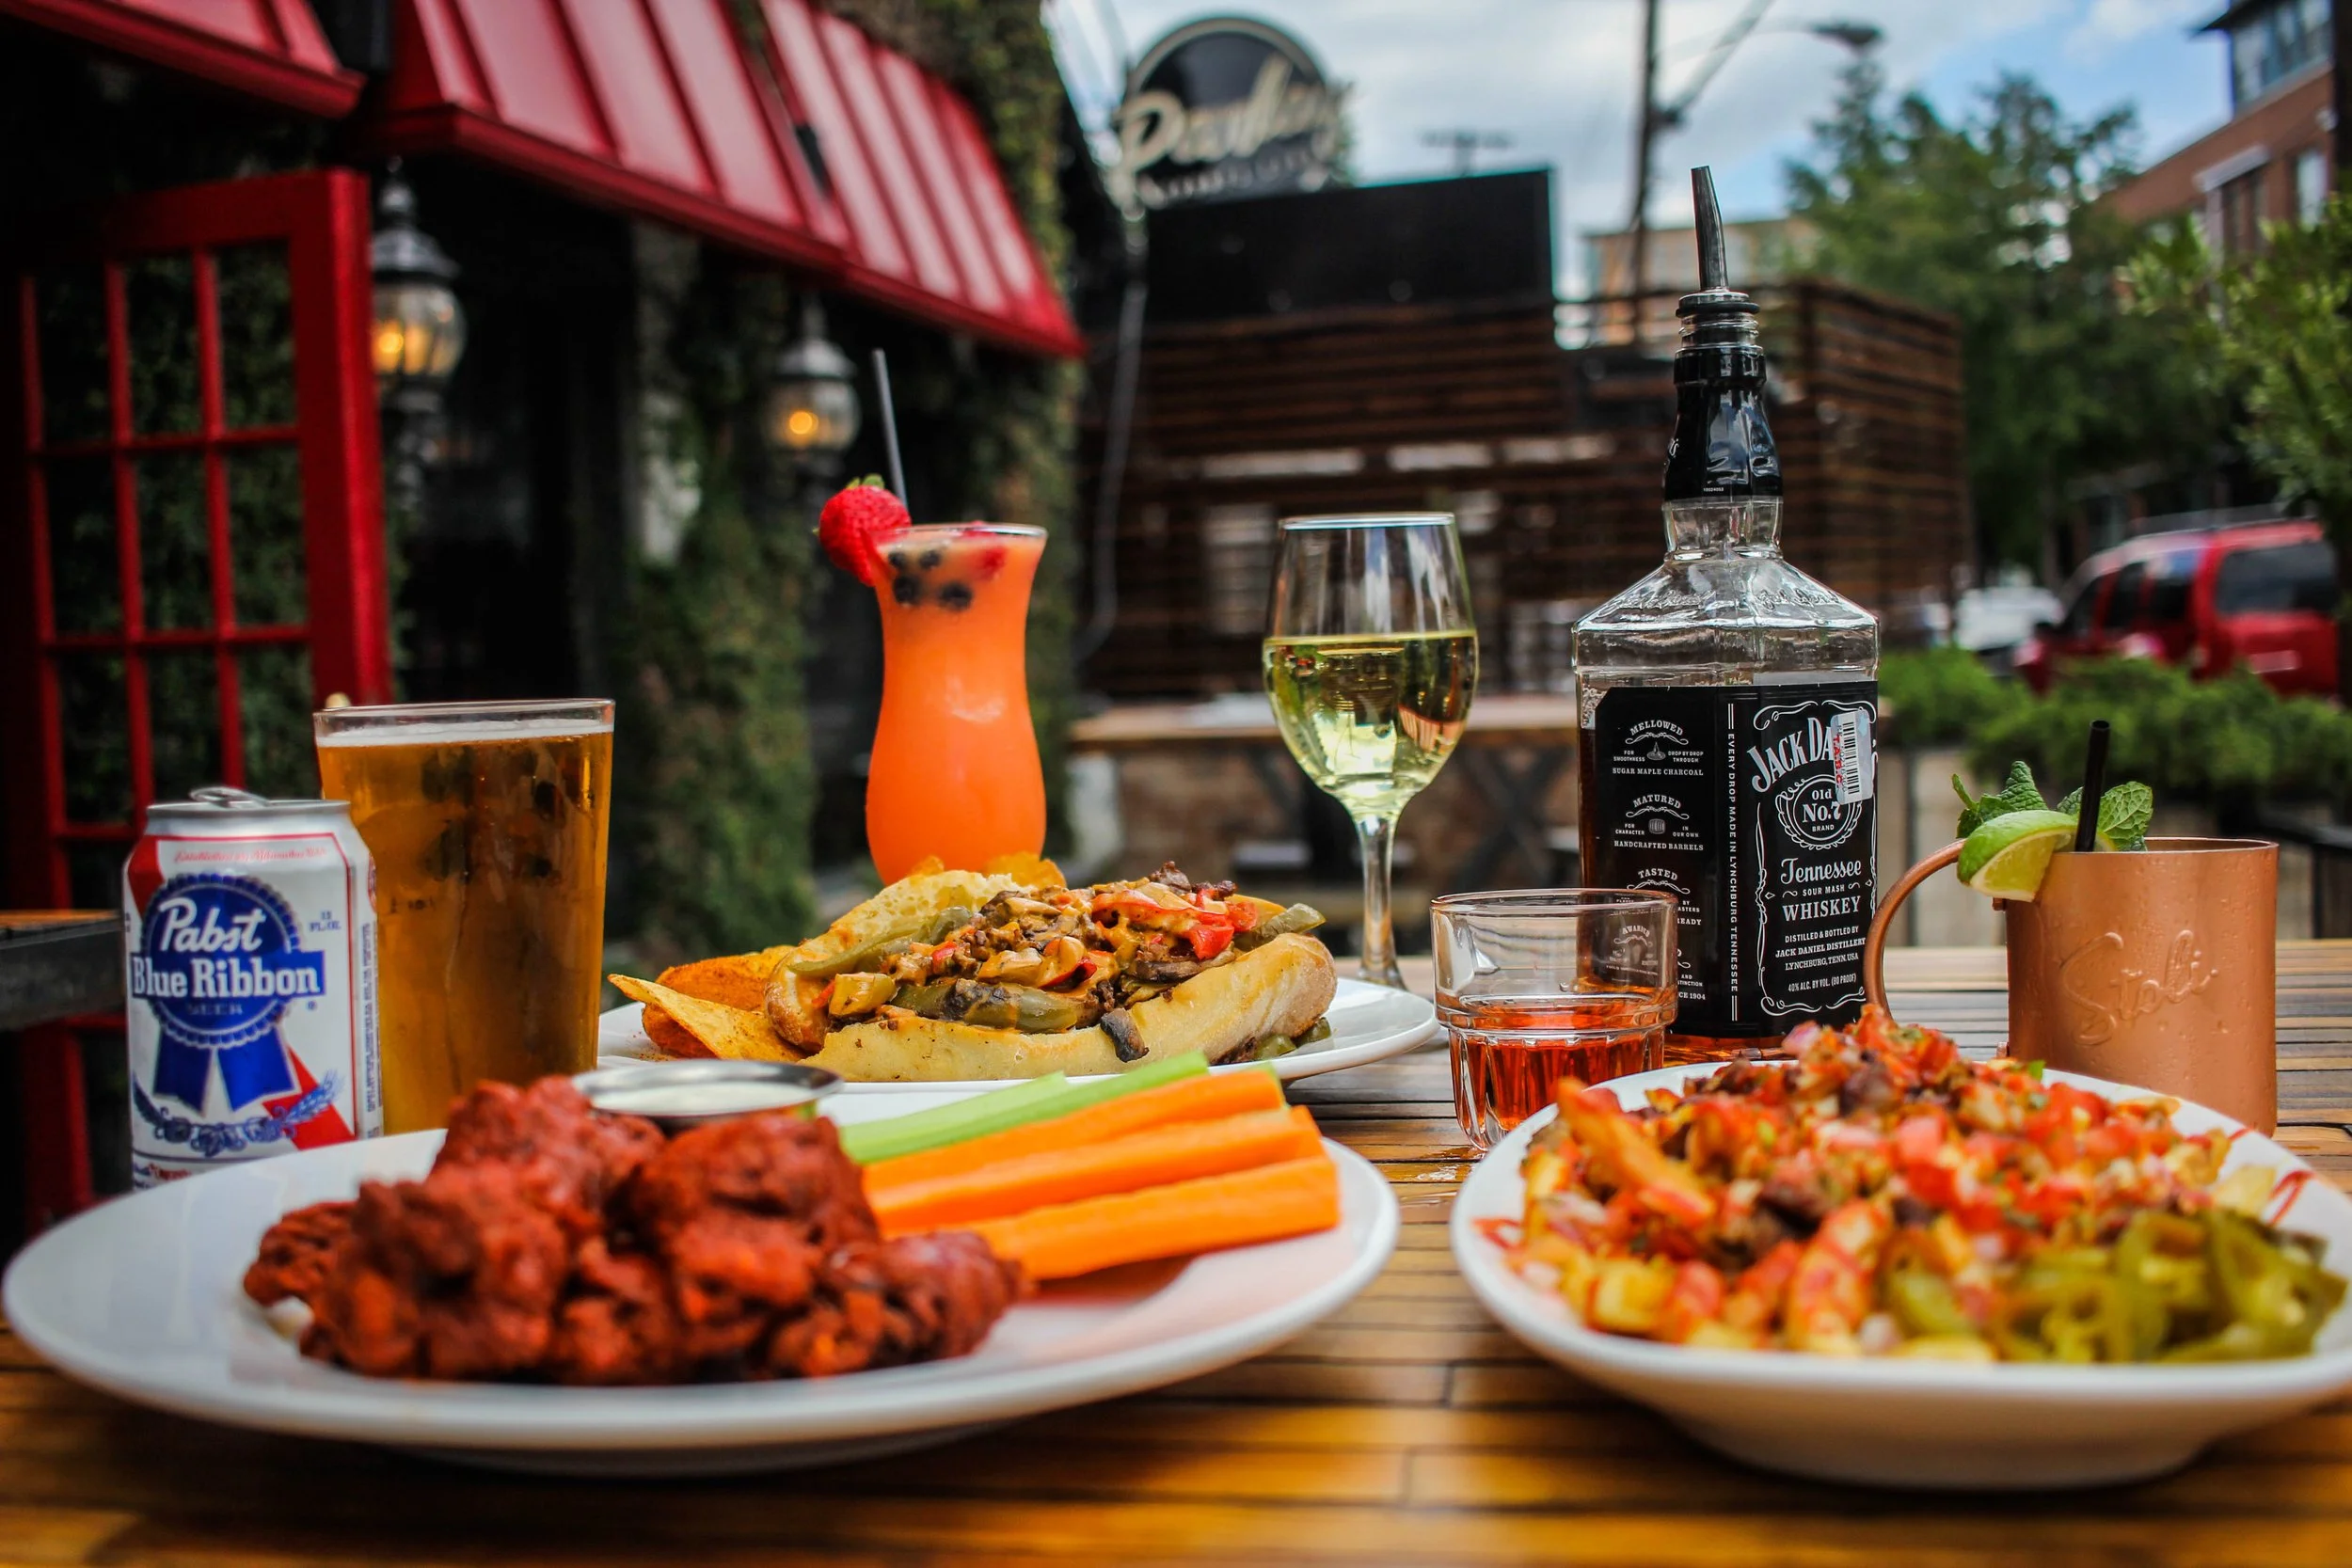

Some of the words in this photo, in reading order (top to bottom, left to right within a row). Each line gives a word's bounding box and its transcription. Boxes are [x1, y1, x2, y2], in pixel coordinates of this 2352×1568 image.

[1629, 720, 1683, 736] MELLOWED
[1727, 734, 1736, 769] EVERY
[1747, 730, 1809, 792] JACK
[1728, 772, 1737, 802] DROP
[1811, 788, 1833, 800] Old
[1632, 794, 1681, 809] MATURED
[1811, 824, 1835, 832] BRAND
[1613, 840, 1667, 849] HANDCRAFTED
[1729, 841, 1737, 852] IN
[1638, 867, 1678, 880] TASTED
[1780, 857, 1862, 885] Tennessee
[1729, 856, 1738, 923] LYNCHBURG
[1802, 887, 1823, 896] SOUR
[1825, 884, 1845, 895] MASH
[1782, 895, 1861, 922] WHISKEY
[158, 897, 267, 952] Pabst
[1785, 934, 1818, 943] DISTILLED
[1824, 927, 1851, 938] BOTTLED
[1851, 926, 1860, 934] BY
[1775, 947, 1797, 958] JACK
[1798, 943, 1826, 955] DANIEL
[1826, 938, 1867, 950] DISTILLERY
[1848, 952, 1859, 960] USA
[1730, 927, 1739, 992] TENNESSEE
[133, 956, 187, 997] Blue
[190, 956, 321, 999] Ribbon
[1788, 983, 1800, 992] 40%
[1800, 980, 1812, 990] ALC.
[1812, 979, 1820, 989] BY
[1820, 976, 1831, 988] VOL.
[1689, 992, 1706, 1001] 1904
